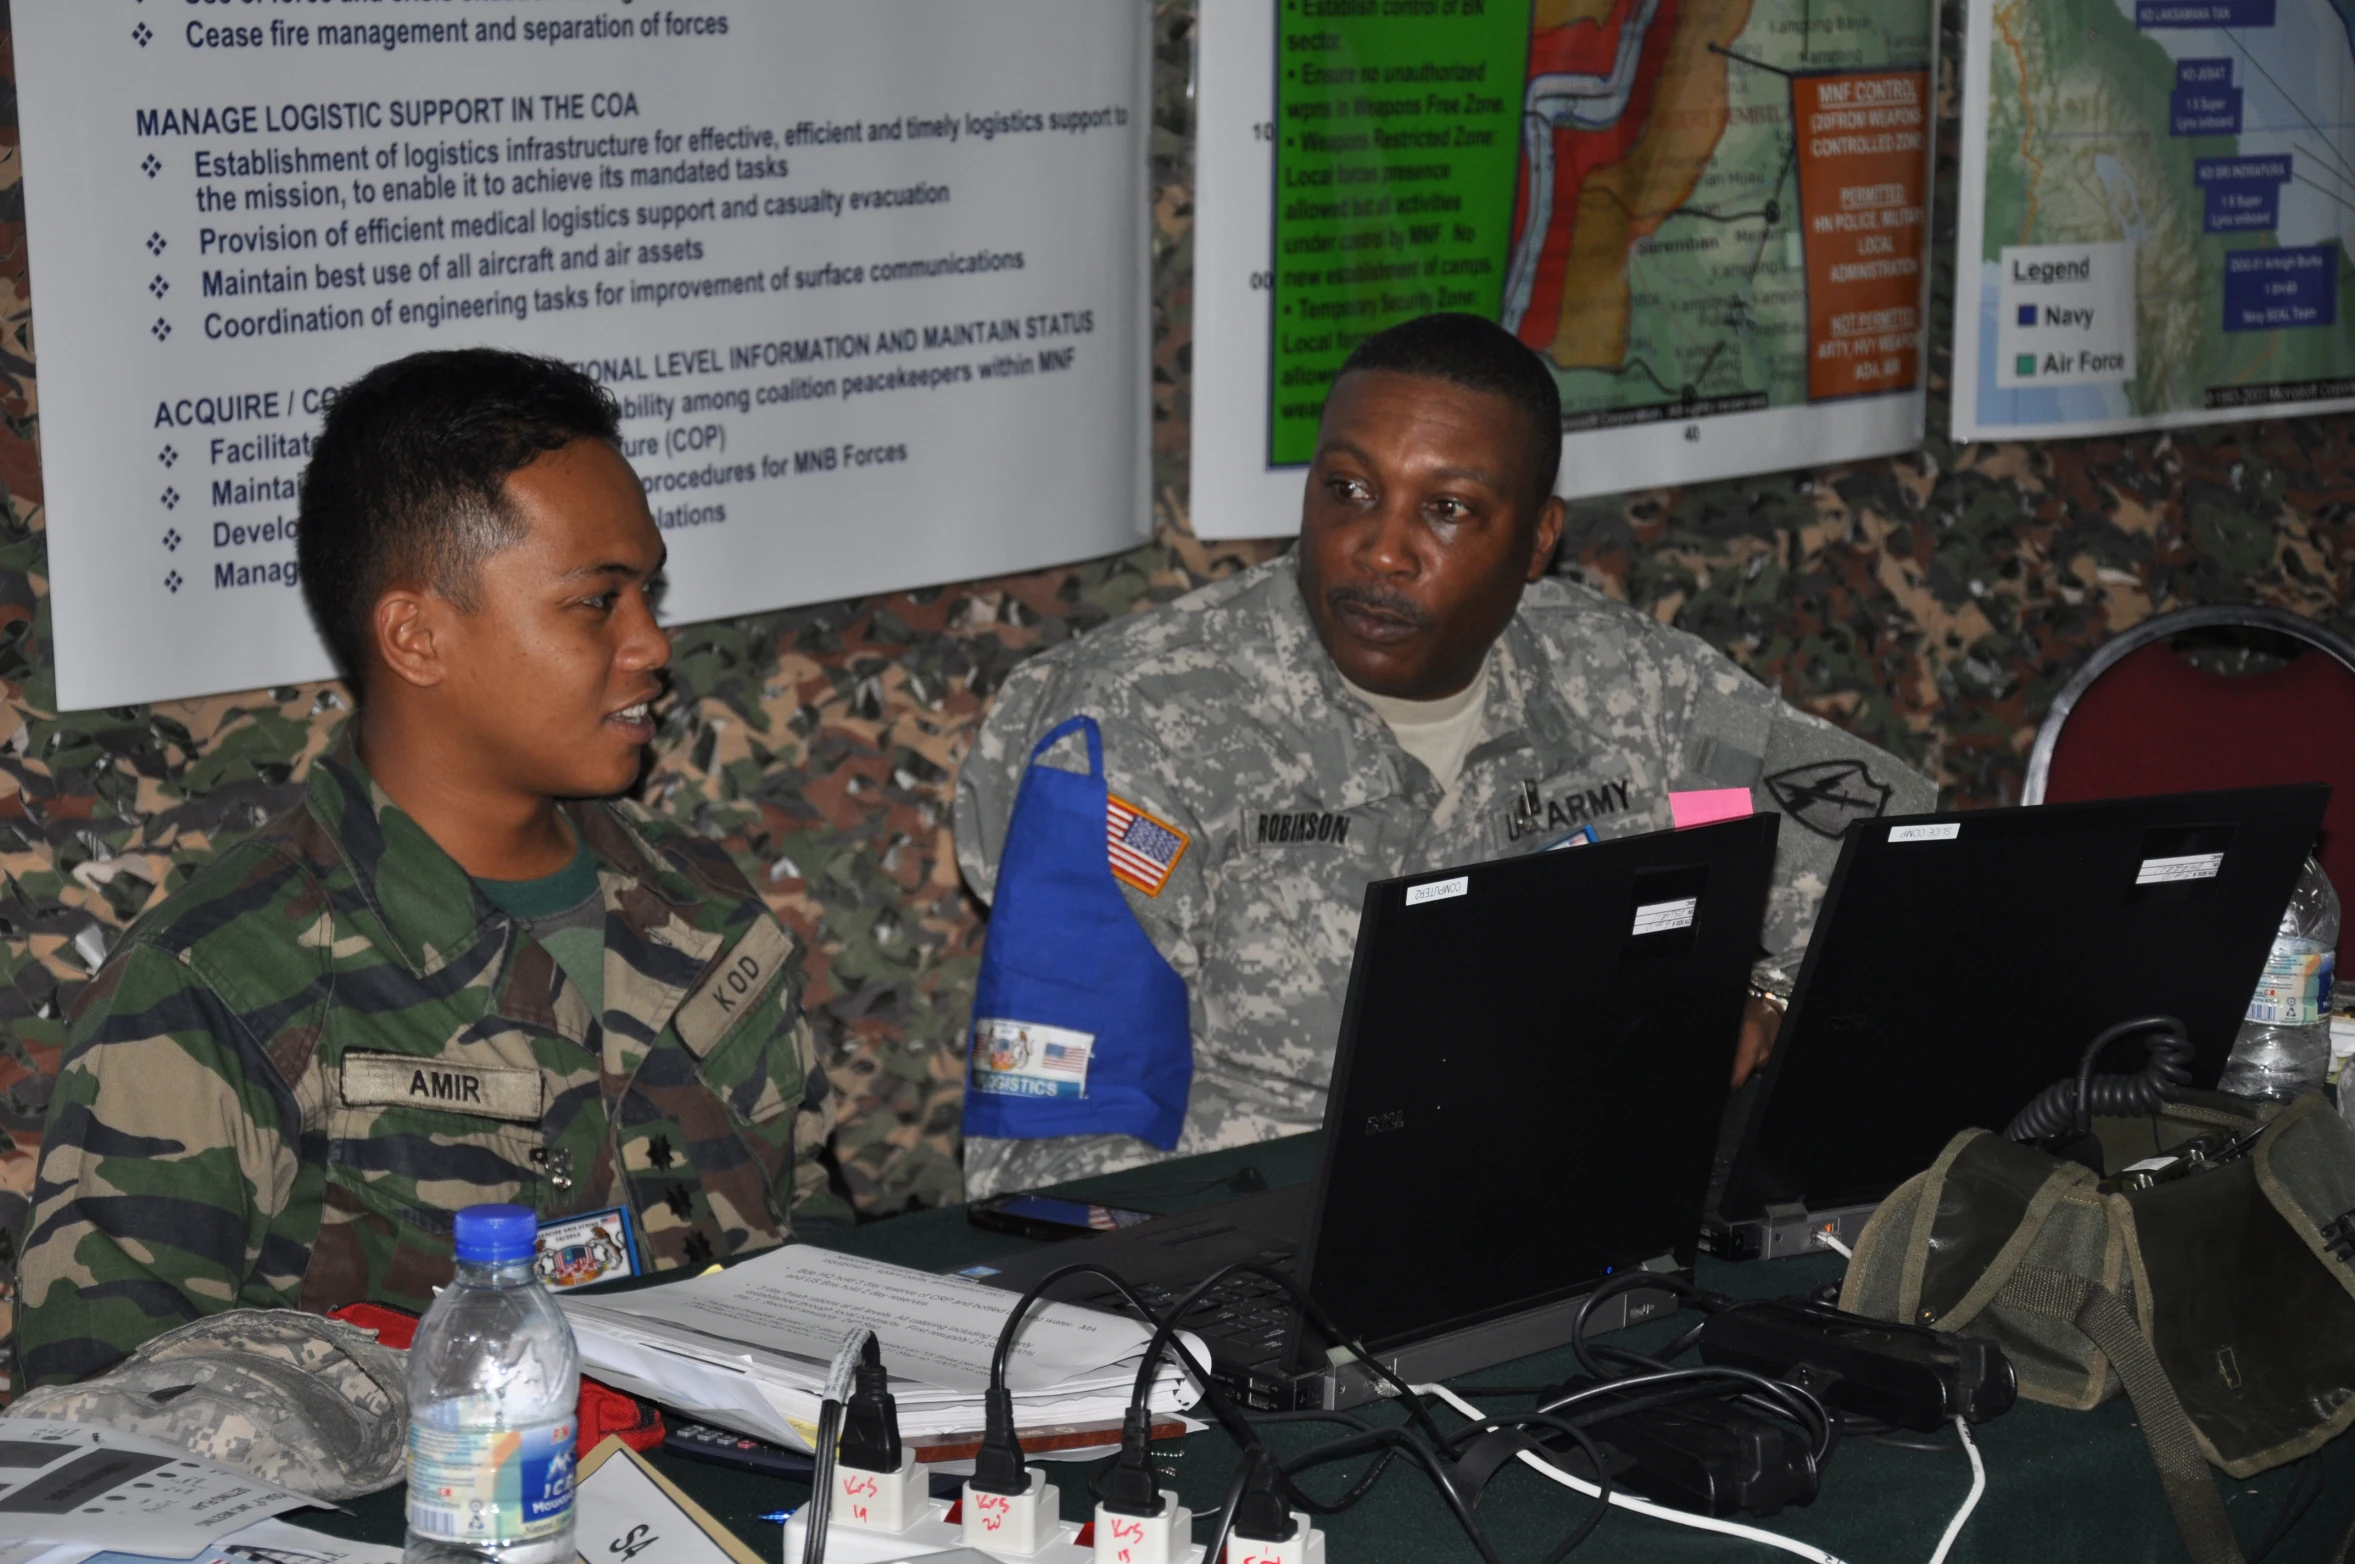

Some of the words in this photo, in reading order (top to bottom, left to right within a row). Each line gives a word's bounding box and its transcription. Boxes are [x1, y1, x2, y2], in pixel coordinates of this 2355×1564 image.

[186, 20, 263, 48] Cease
[269, 19, 310, 47] fire
[317, 17, 469, 51] management
[475, 15, 517, 43] and
[523, 12, 634, 47] separation
[640, 11, 661, 38] of
[664, 10, 729, 37] forces
[1818, 83, 1851, 103] MNF
[1855, 80, 1916, 100] CONTROL
[136, 105, 259, 137] MANAGE
[265, 101, 382, 133] LOGISTIC
[389, 96, 505, 128] SUPPORT
[511, 95, 534, 122] IN
[540, 93, 585, 121] THE
[591, 91, 640, 119] COA
[194, 145, 370, 179] Establishment
[375, 141, 398, 170] of
[404, 139, 500, 172] logistics
[506, 133, 649, 163] infrastructure
[654, 129, 683, 155] for
[688, 125, 779, 152] effective,
[784, 120, 863, 147] efficient
[867, 117, 902, 143] and
[906, 114, 960, 142] timely
[965, 110, 1044, 141] logistics
[1048, 107, 1112, 134] support
[1114, 106, 1129, 125] to
[1810, 135, 1894, 156] CONTROLLED
[195, 185, 237, 213] the
[244, 180, 346, 210] mission,
[352, 179, 376, 205] to
[382, 170, 457, 203] enable
[463, 171, 478, 198] it
[483, 172, 506, 196] to
[512, 167, 593, 195] achieve
[600, 164, 624, 189] its
[630, 157, 730, 187] mandated
[735, 150, 789, 181] tasks
[200, 223, 318, 255] Provision
[325, 219, 349, 247] of
[355, 216, 445, 246] efficient
[451, 208, 536, 239] medical
[542, 204, 631, 237] logistics
[636, 198, 716, 229] support
[721, 194, 759, 220] and
[764, 189, 844, 217] casualty
[849, 181, 950, 210] evacuation
[202, 265, 308, 298] Maintain
[315, 262, 366, 290] best
[372, 263, 412, 286] use
[418, 254, 441, 282] of
[446, 253, 471, 280] all
[478, 246, 555, 278] aircraft
[560, 243, 599, 271] and
[605, 241, 632, 267] air
[637, 238, 704, 264] assets
[2013, 257, 2090, 282] Legend
[204, 304, 364, 341] Coordination
[371, 298, 393, 327] of
[399, 290, 528, 329] engineering
[533, 285, 589, 313] tasks
[594, 281, 625, 306] for
[630, 271, 765, 307] improvement
[770, 266, 790, 292] of
[794, 262, 865, 290] surface
[869, 249, 1025, 283] communications
[2046, 306, 2094, 329] Navy
[655, 349, 724, 379] LEVEL
[729, 333, 871, 371] INFORMATION
[875, 328, 918, 354] AND
[923, 319, 1021, 350] MAINTAIN
[1025, 309, 1094, 340] STATUS
[681, 388, 751, 415] among
[756, 377, 837, 406] coalition
[842, 364, 973, 401] peacekeepers
[977, 354, 1034, 380] within
[1038, 346, 1075, 373] MNF
[2043, 354, 2074, 374] Air
[2080, 351, 2125, 372] Force
[154, 391, 280, 429] ACQUIRE
[665, 424, 726, 459] (COP)
[761, 454, 789, 479] for
[794, 446, 838, 475] MNB
[843, 443, 908, 467] Forces
[213, 515, 299, 547] Develo
[215, 559, 298, 590] Manag
[1547, 780, 1632, 830] ARMY
[1257, 812, 1350, 845] ROBINSON
[1899, 827, 1926, 839] COMP
[1414, 881, 1461, 900] COMPUTER2
[712, 955, 760, 1013] KOD
[409, 1070, 481, 1103] AMIR
[544, 1474, 574, 1499] ICE
[609, 1524, 660, 1563] S4
